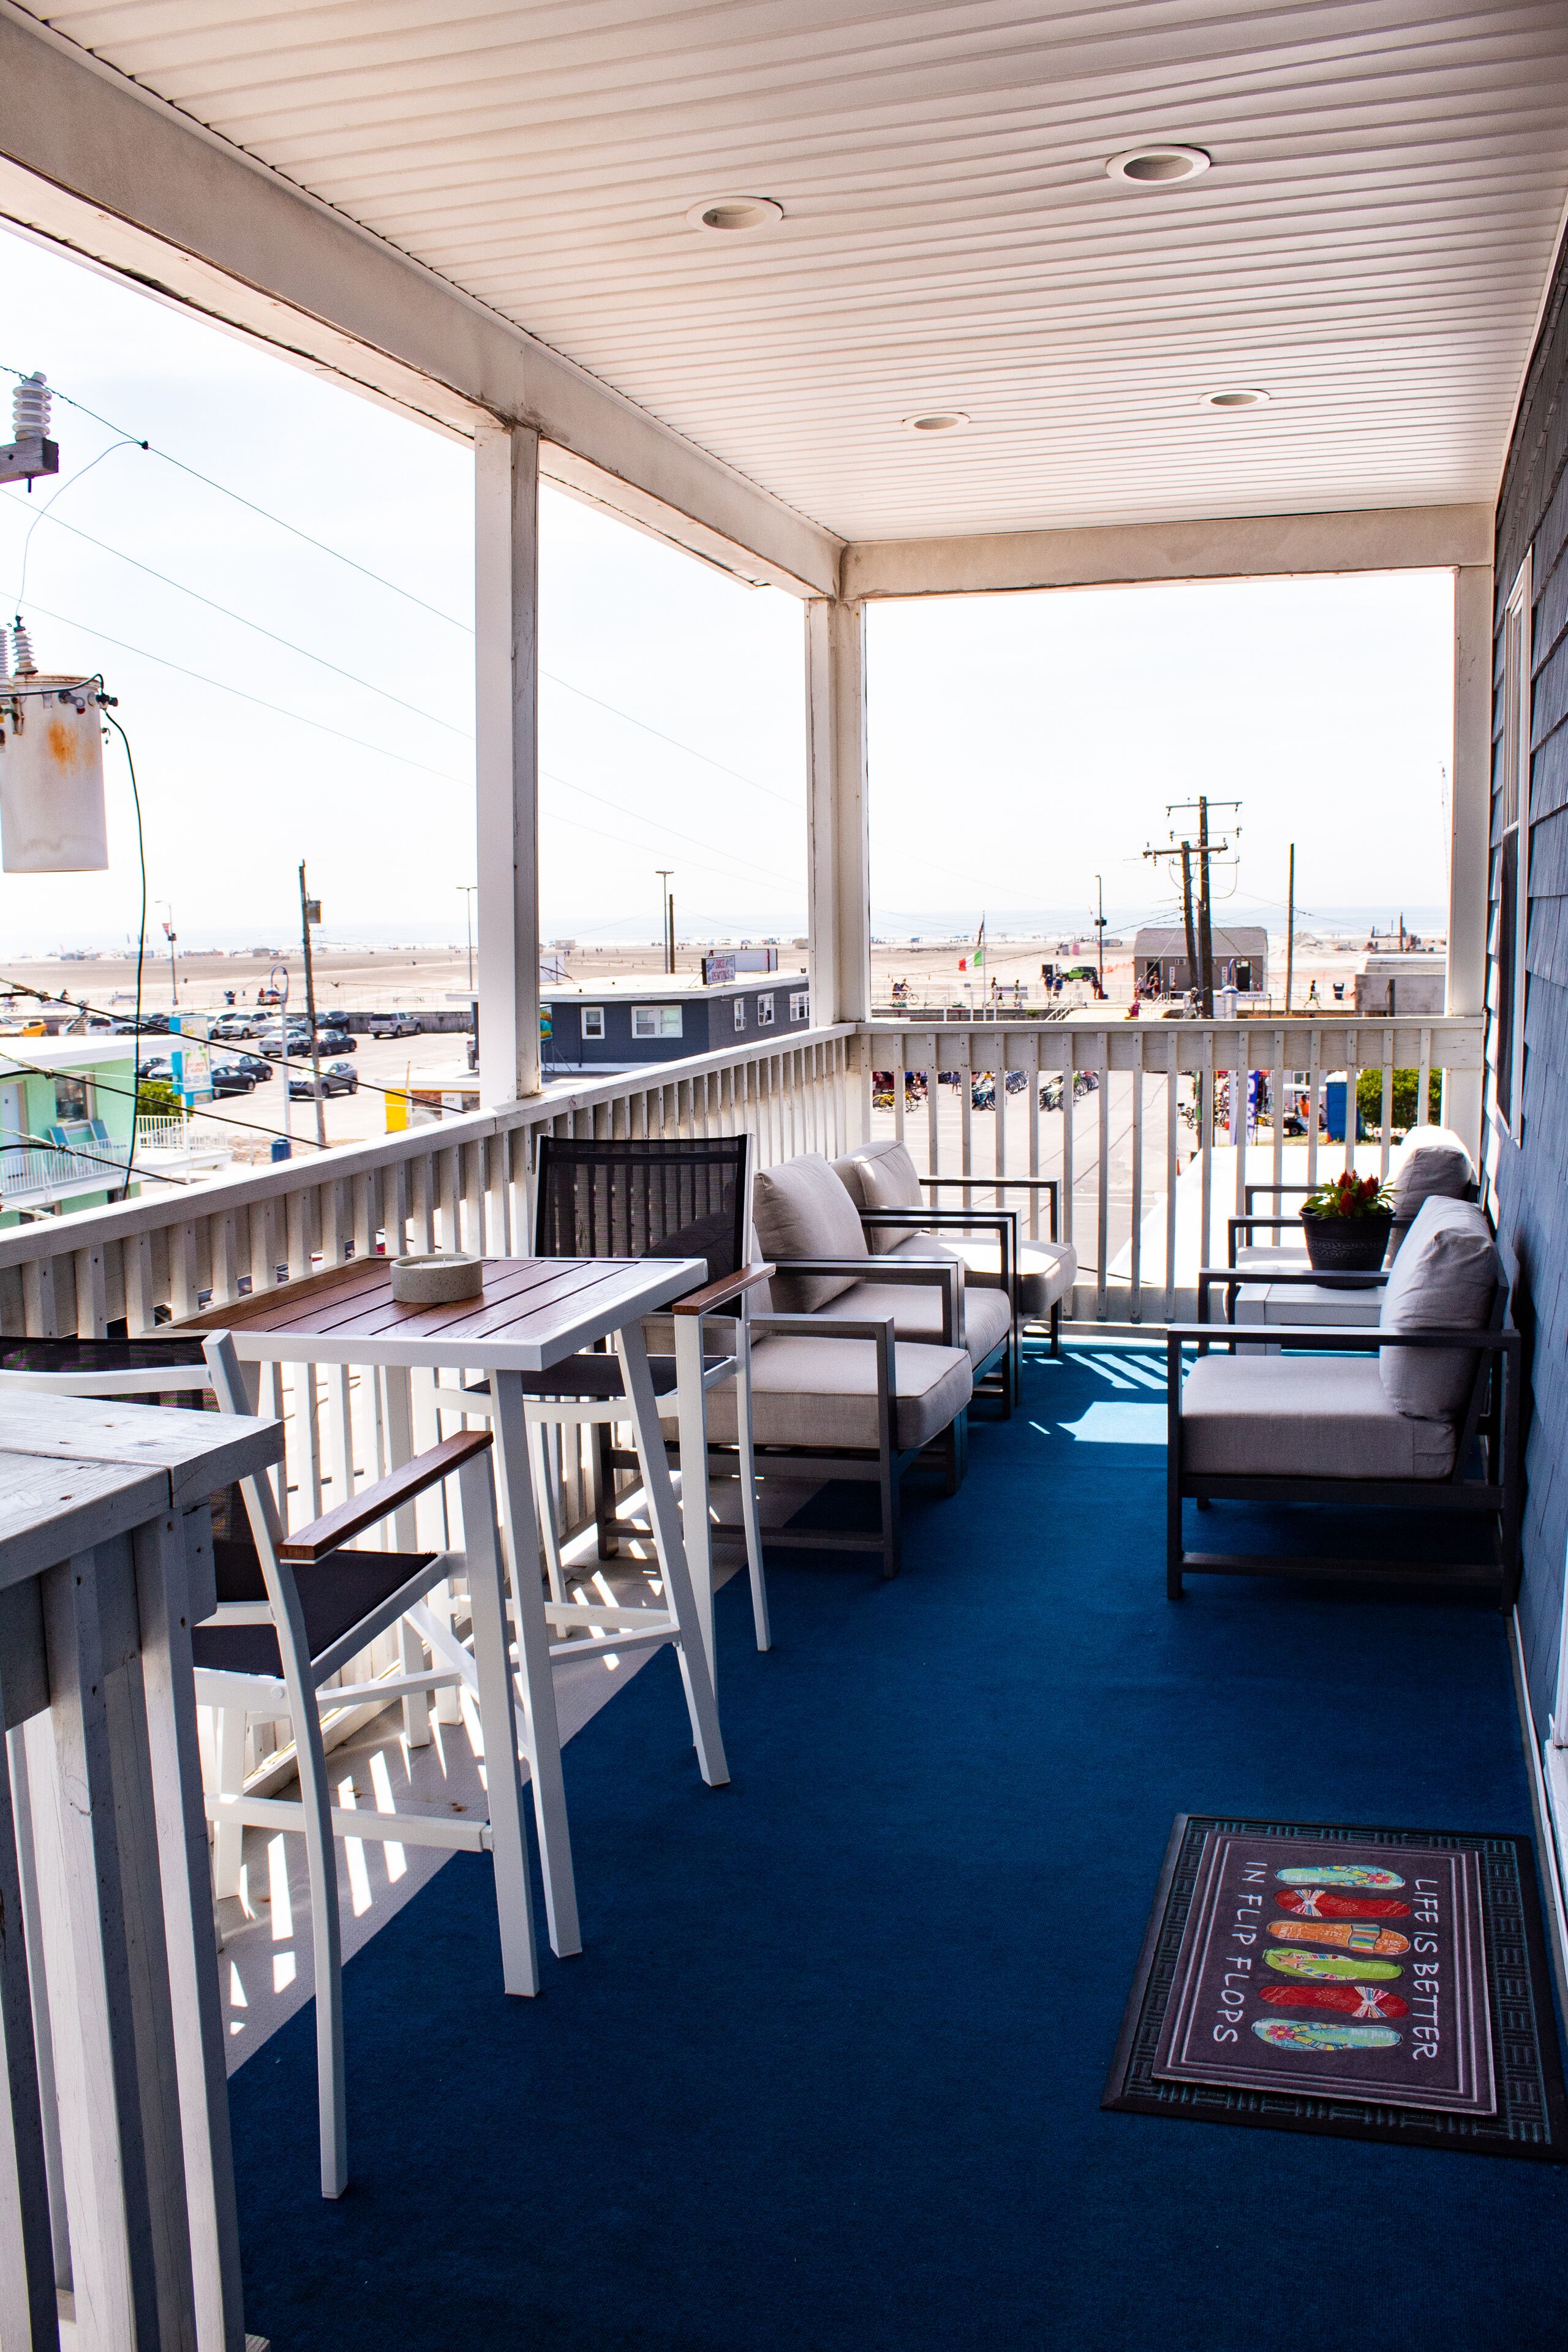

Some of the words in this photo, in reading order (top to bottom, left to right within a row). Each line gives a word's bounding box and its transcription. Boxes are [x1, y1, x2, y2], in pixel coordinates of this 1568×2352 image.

[1242, 1861, 1267, 1883] IN
[1231, 1894, 1262, 1945] FLIP
[1412, 1879, 1438, 1923] LIFE
[1413, 1932, 1438, 1953] IS
[1213, 1957, 1251, 2043] FLOPS
[1411, 1962, 1439, 2060] BETTER
